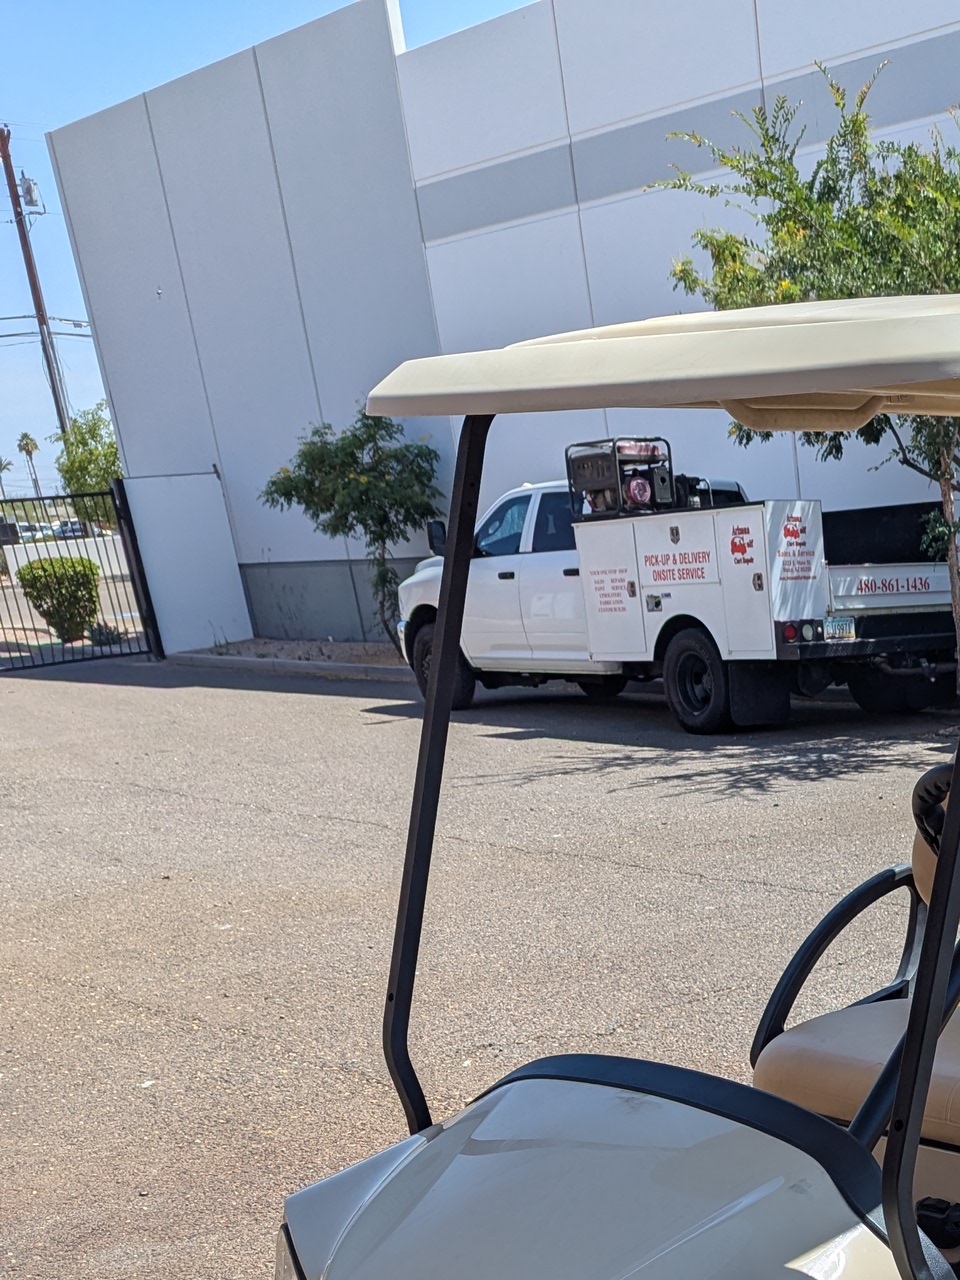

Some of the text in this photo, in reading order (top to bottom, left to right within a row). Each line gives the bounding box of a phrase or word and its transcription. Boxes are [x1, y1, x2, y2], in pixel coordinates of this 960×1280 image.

[644, 551, 711, 567] PICK-UP & DELIVERY
[652, 567, 706, 582] ONSITE SERVICE
[856, 576, 931, 594] 480-861-1436
